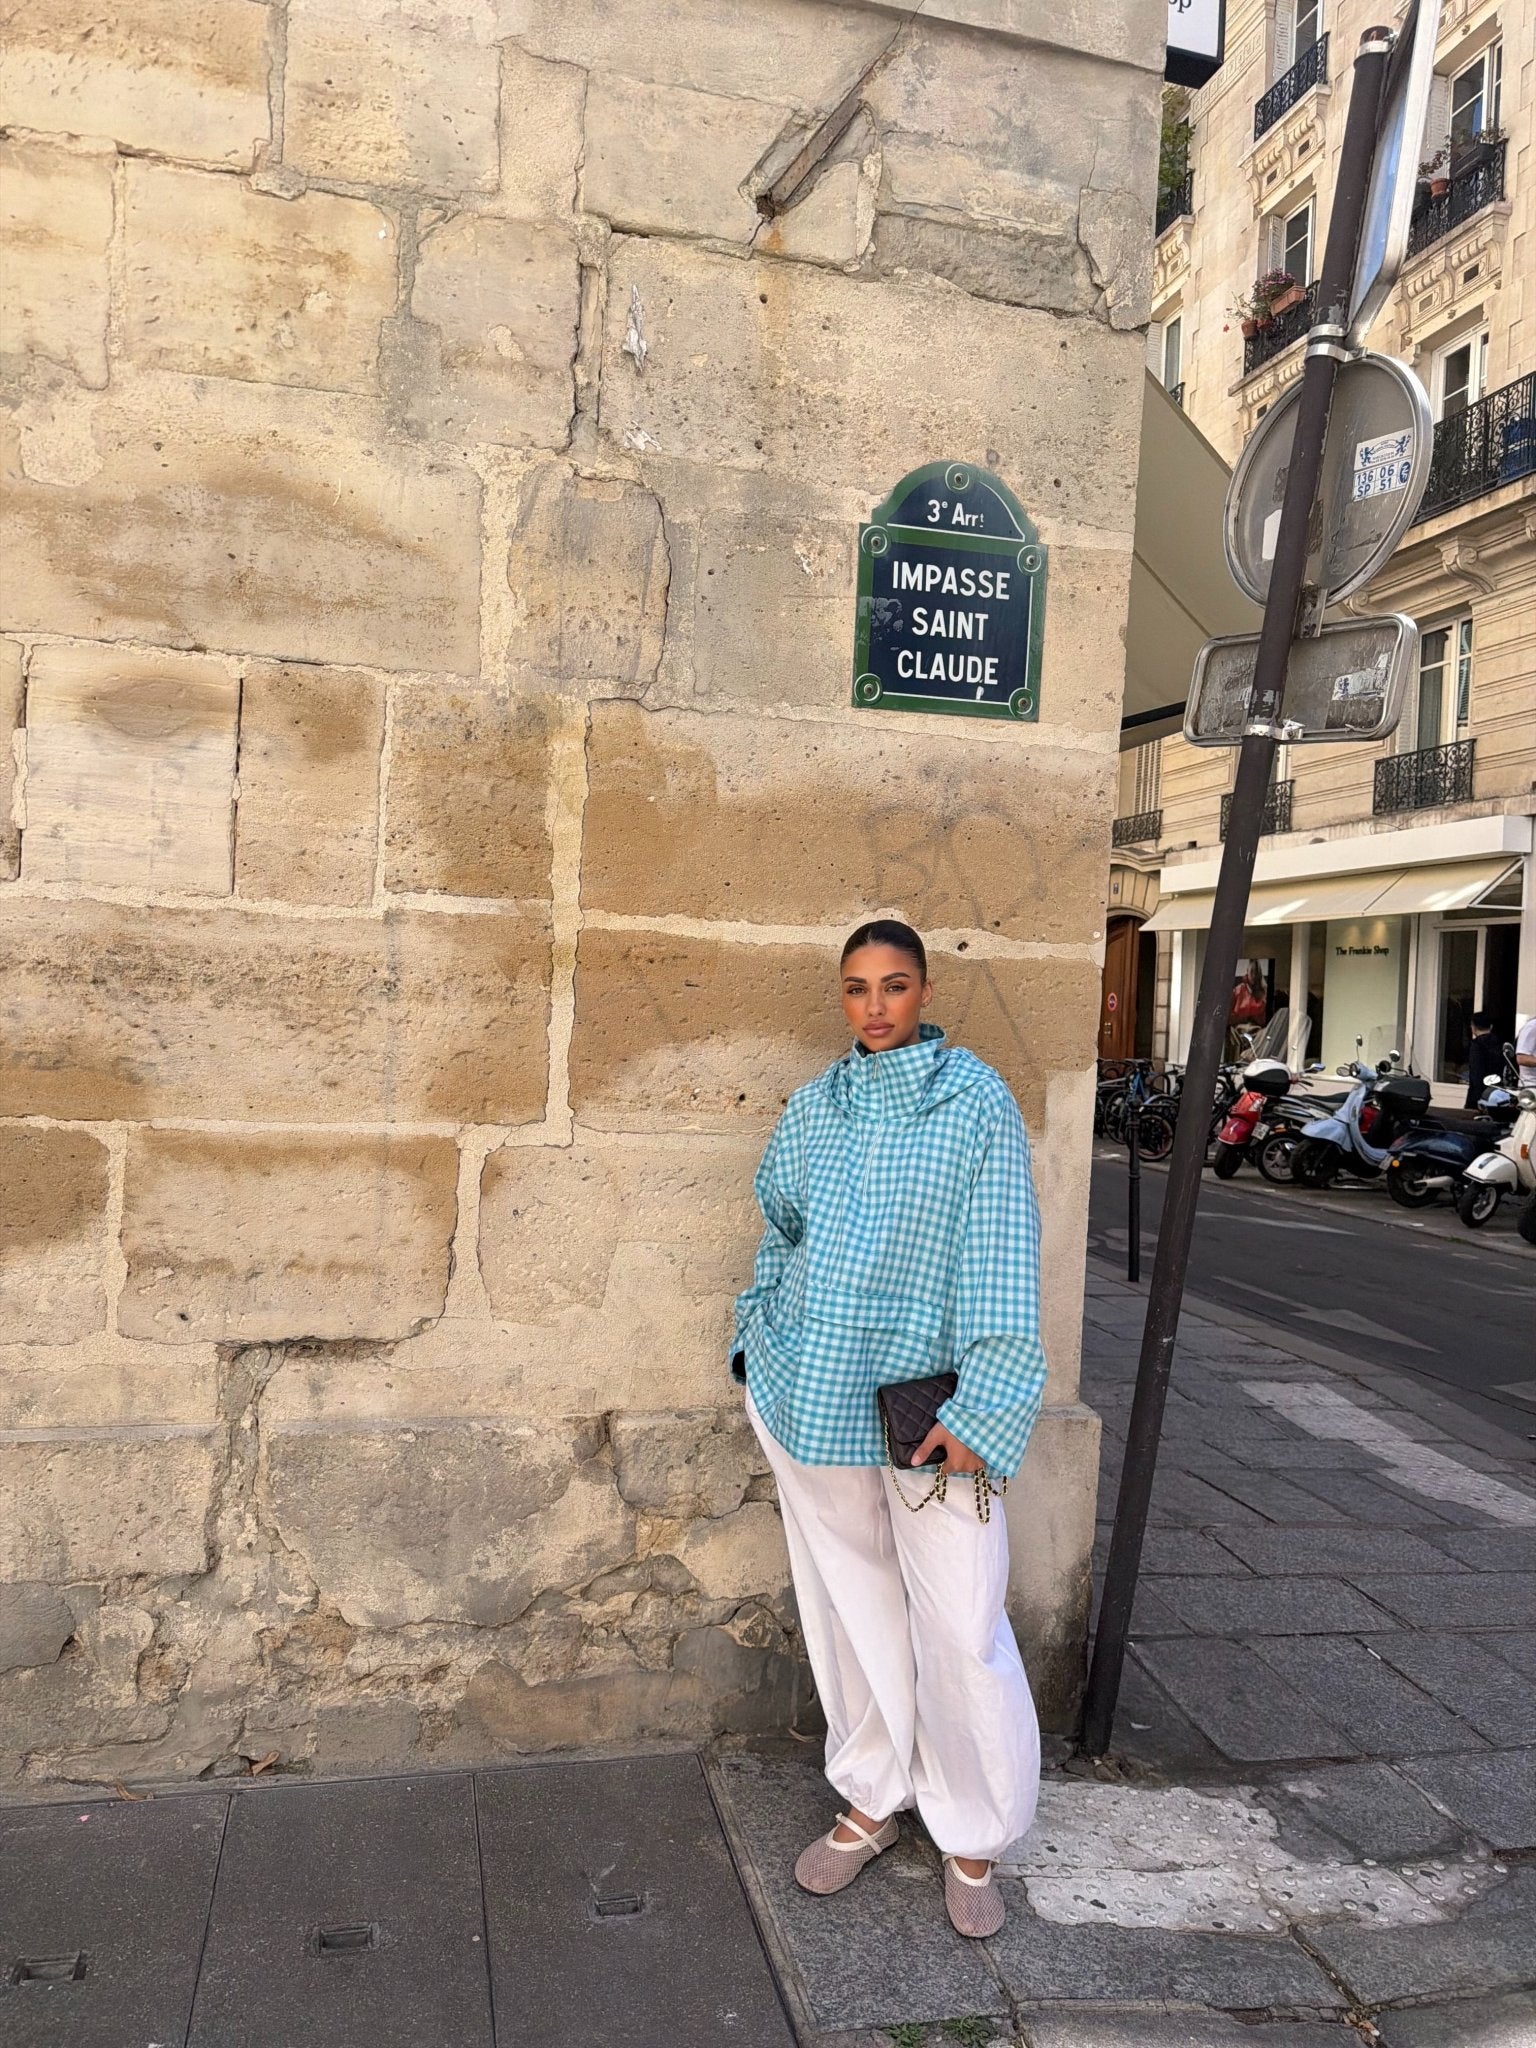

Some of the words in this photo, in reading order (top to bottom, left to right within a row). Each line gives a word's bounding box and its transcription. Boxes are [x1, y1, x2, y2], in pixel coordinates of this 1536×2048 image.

[1357, 471, 1373, 486] 136
[1380, 464, 1394, 478] 06
[1357, 484, 1371, 497] SP
[1380, 478, 1392, 490] 51
[892, 561, 1010, 600] IMPASSE
[911, 607, 988, 640] SAINT
[897, 650, 999, 685] CLAUDE
[1336, 946, 1347, 955] The
[1374, 945, 1389, 956] Shop
